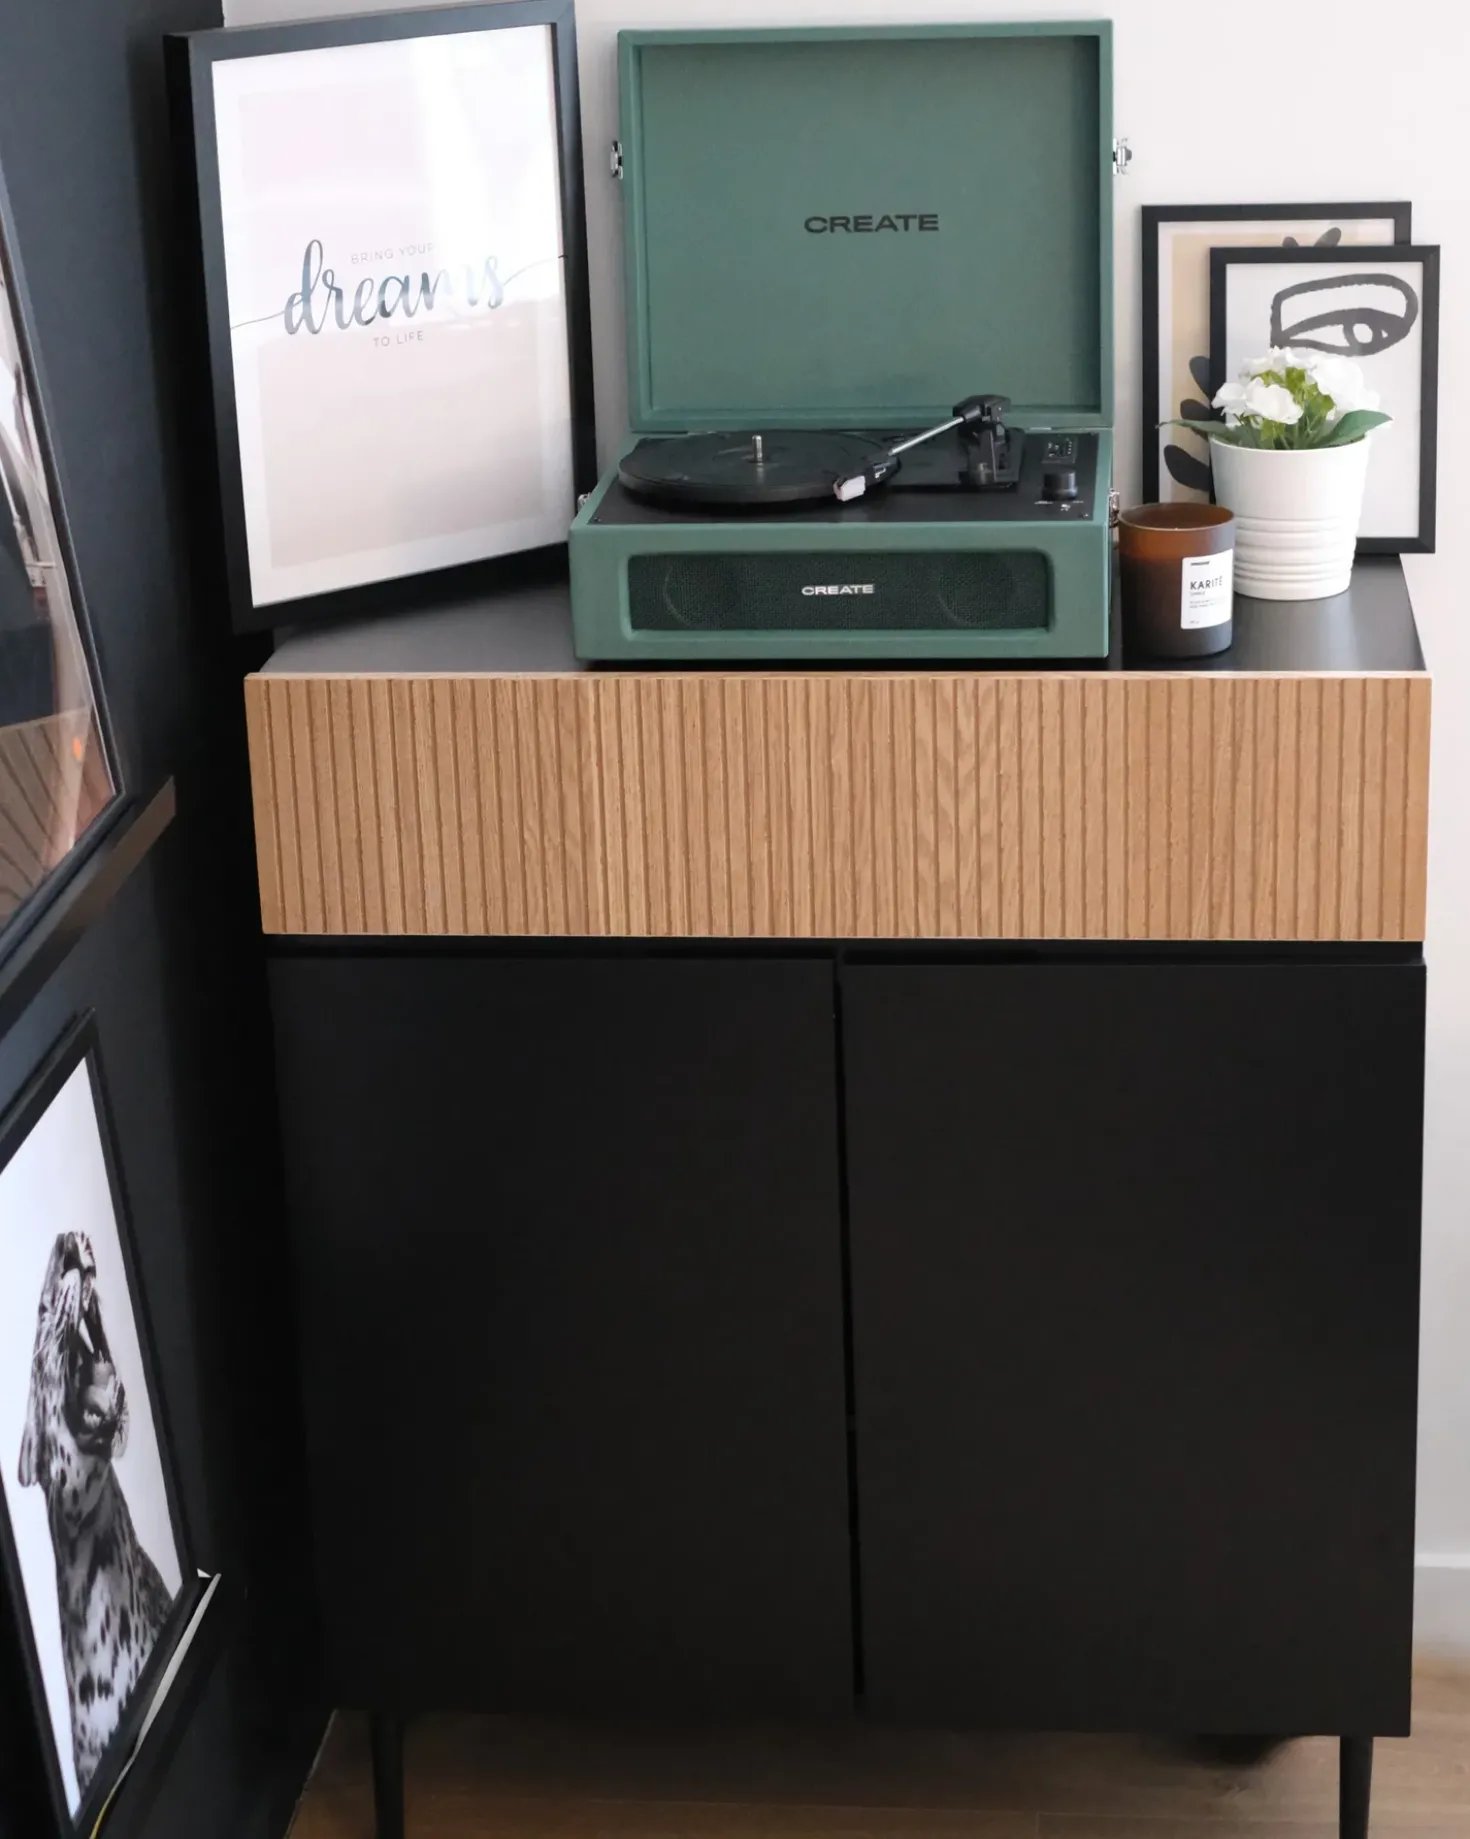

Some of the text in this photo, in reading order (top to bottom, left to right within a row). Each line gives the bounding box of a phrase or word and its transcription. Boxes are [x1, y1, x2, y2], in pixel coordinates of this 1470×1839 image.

[804, 214, 939, 233] CREATE
[350, 248, 394, 264] BRING
[283, 239, 505, 335] dreams
[373, 331, 424, 348] TO LIFE
[801, 584, 874, 596] CREATE
